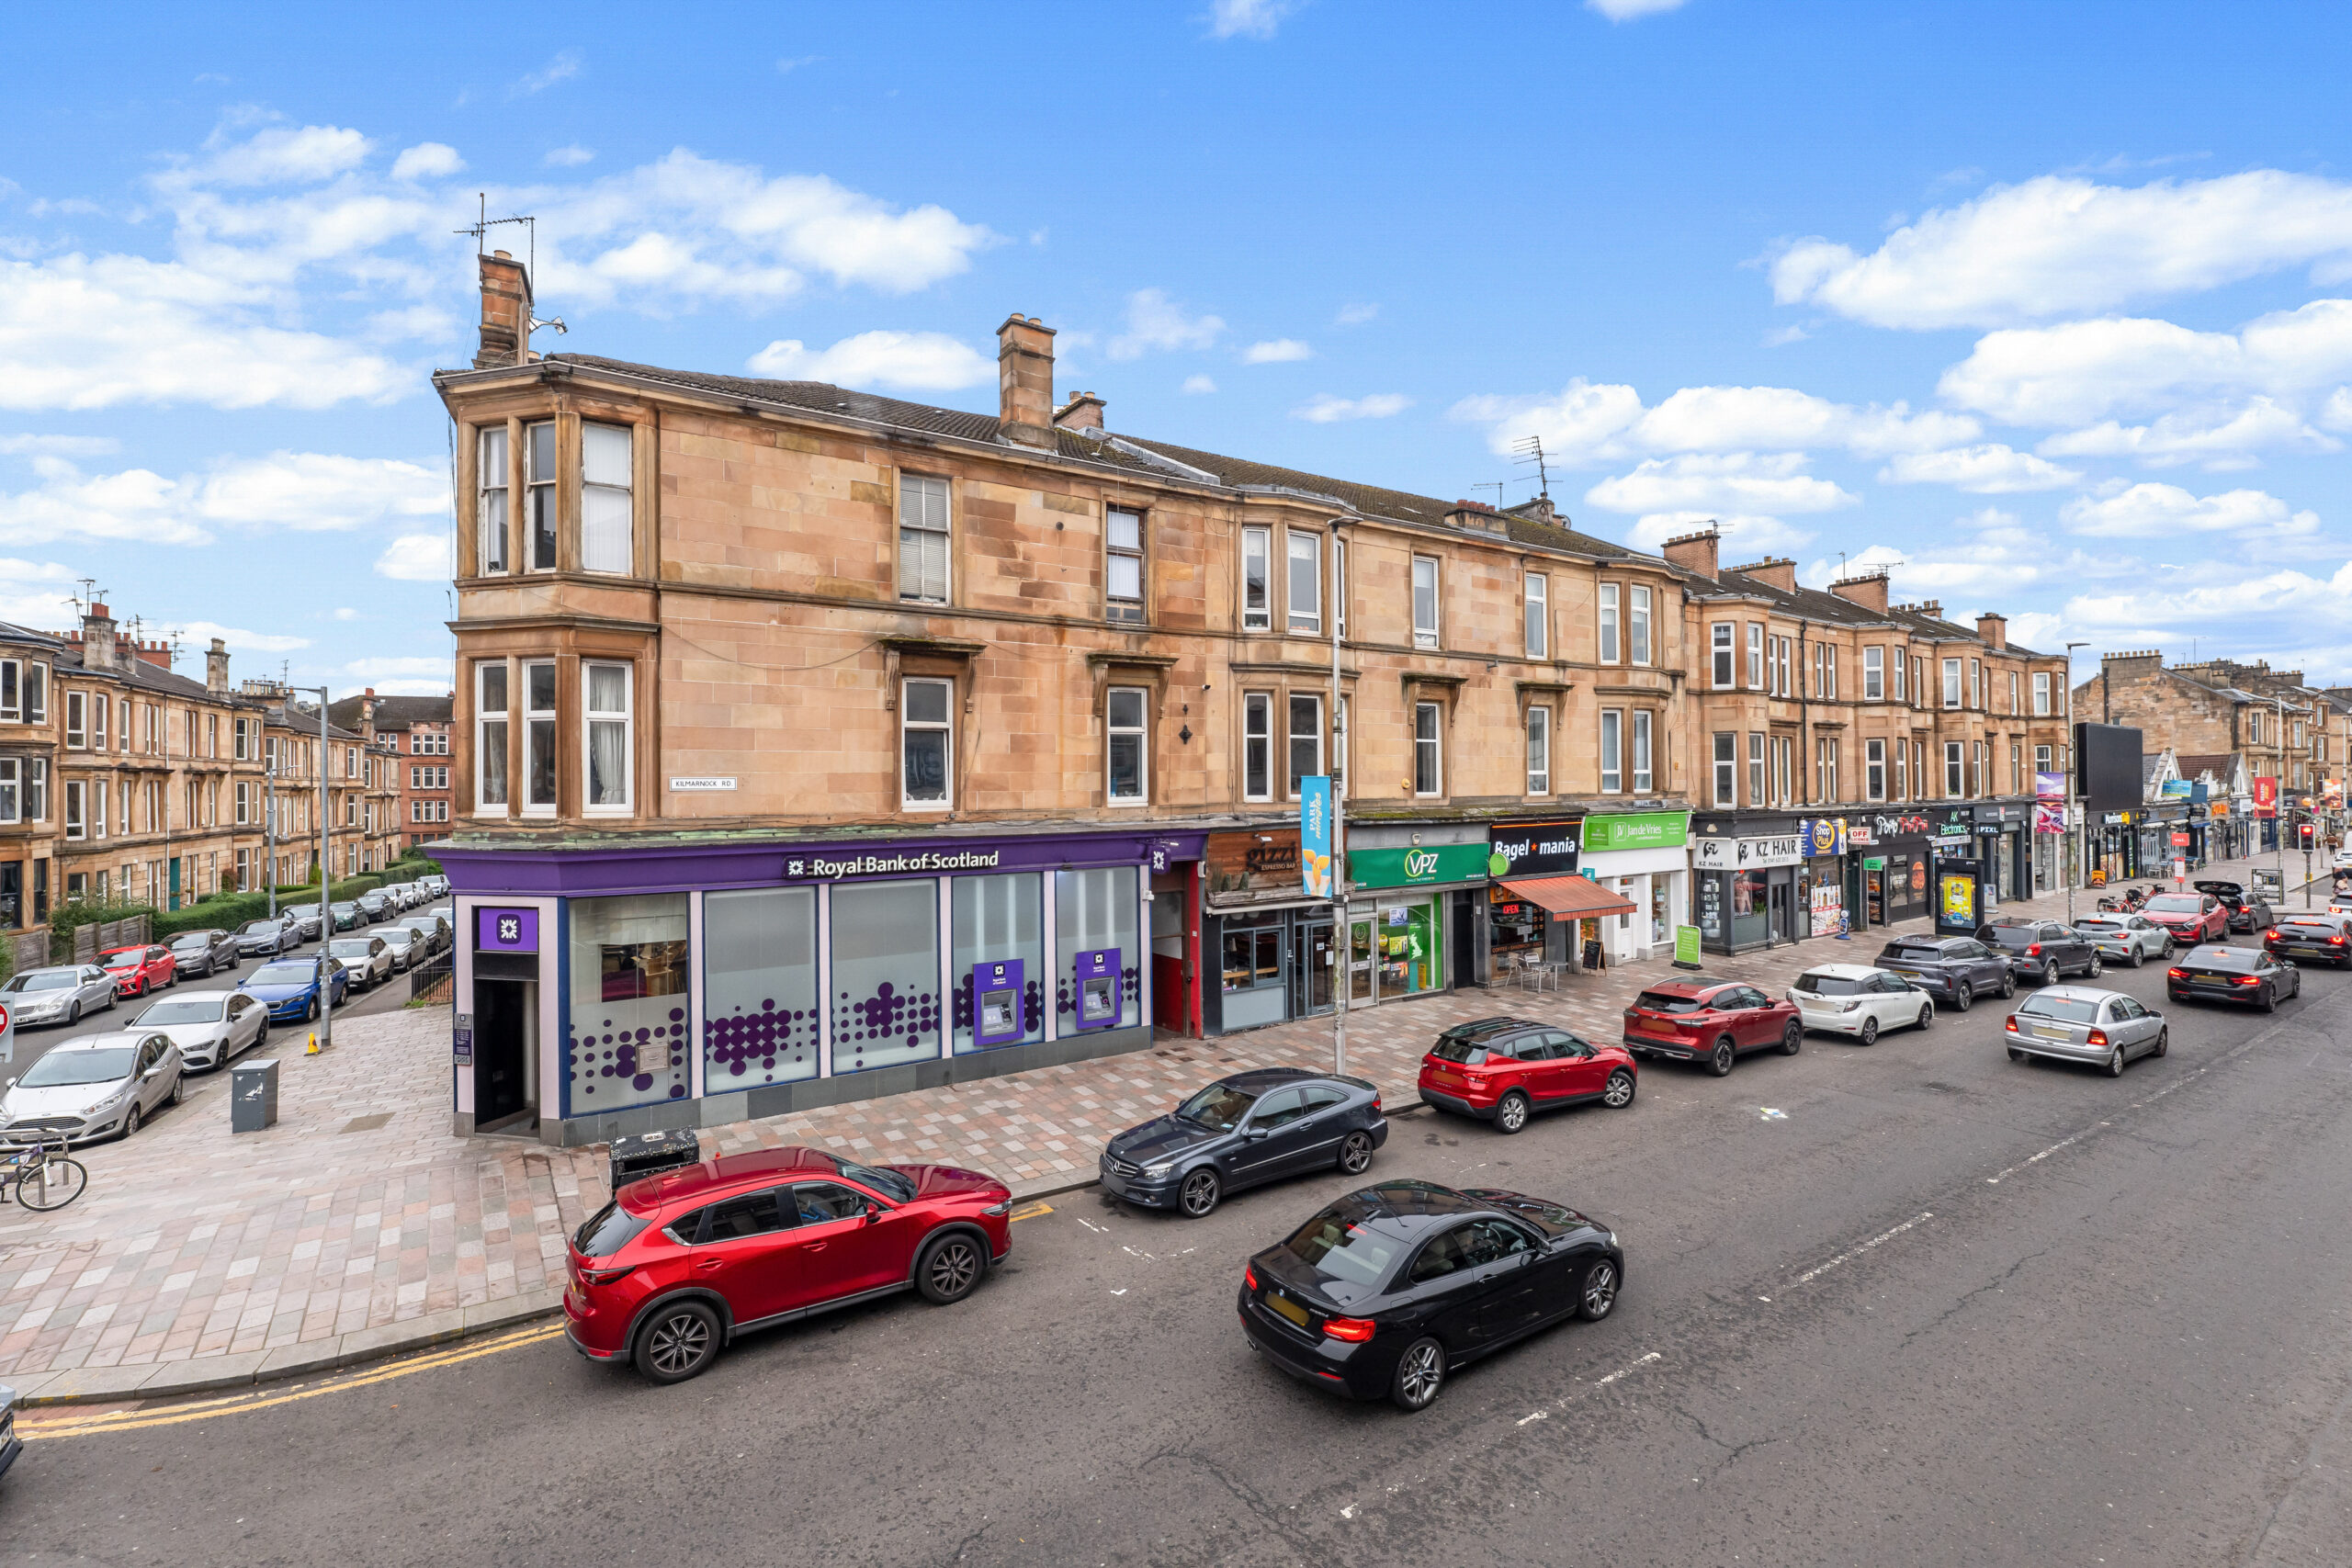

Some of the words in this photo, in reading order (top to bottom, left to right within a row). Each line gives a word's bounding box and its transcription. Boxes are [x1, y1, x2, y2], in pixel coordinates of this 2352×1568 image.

[1815, 826, 1831, 837] Shop
[1816, 835, 1829, 845] Plus
[1247, 840, 1296, 874] gizzi
[1495, 839, 1530, 861] Bagel
[1539, 836, 1576, 854] mania
[1756, 841, 1769, 857] KZ
[1772, 840, 1797, 856] HAIR
[813, 856, 862, 880] Royal
[865, 854, 907, 873] Bank
[910, 853, 929, 870] of
[932, 851, 999, 869] Scotland
[1409, 853, 1440, 874] VPZ
[1503, 904, 1520, 915] OPEN
